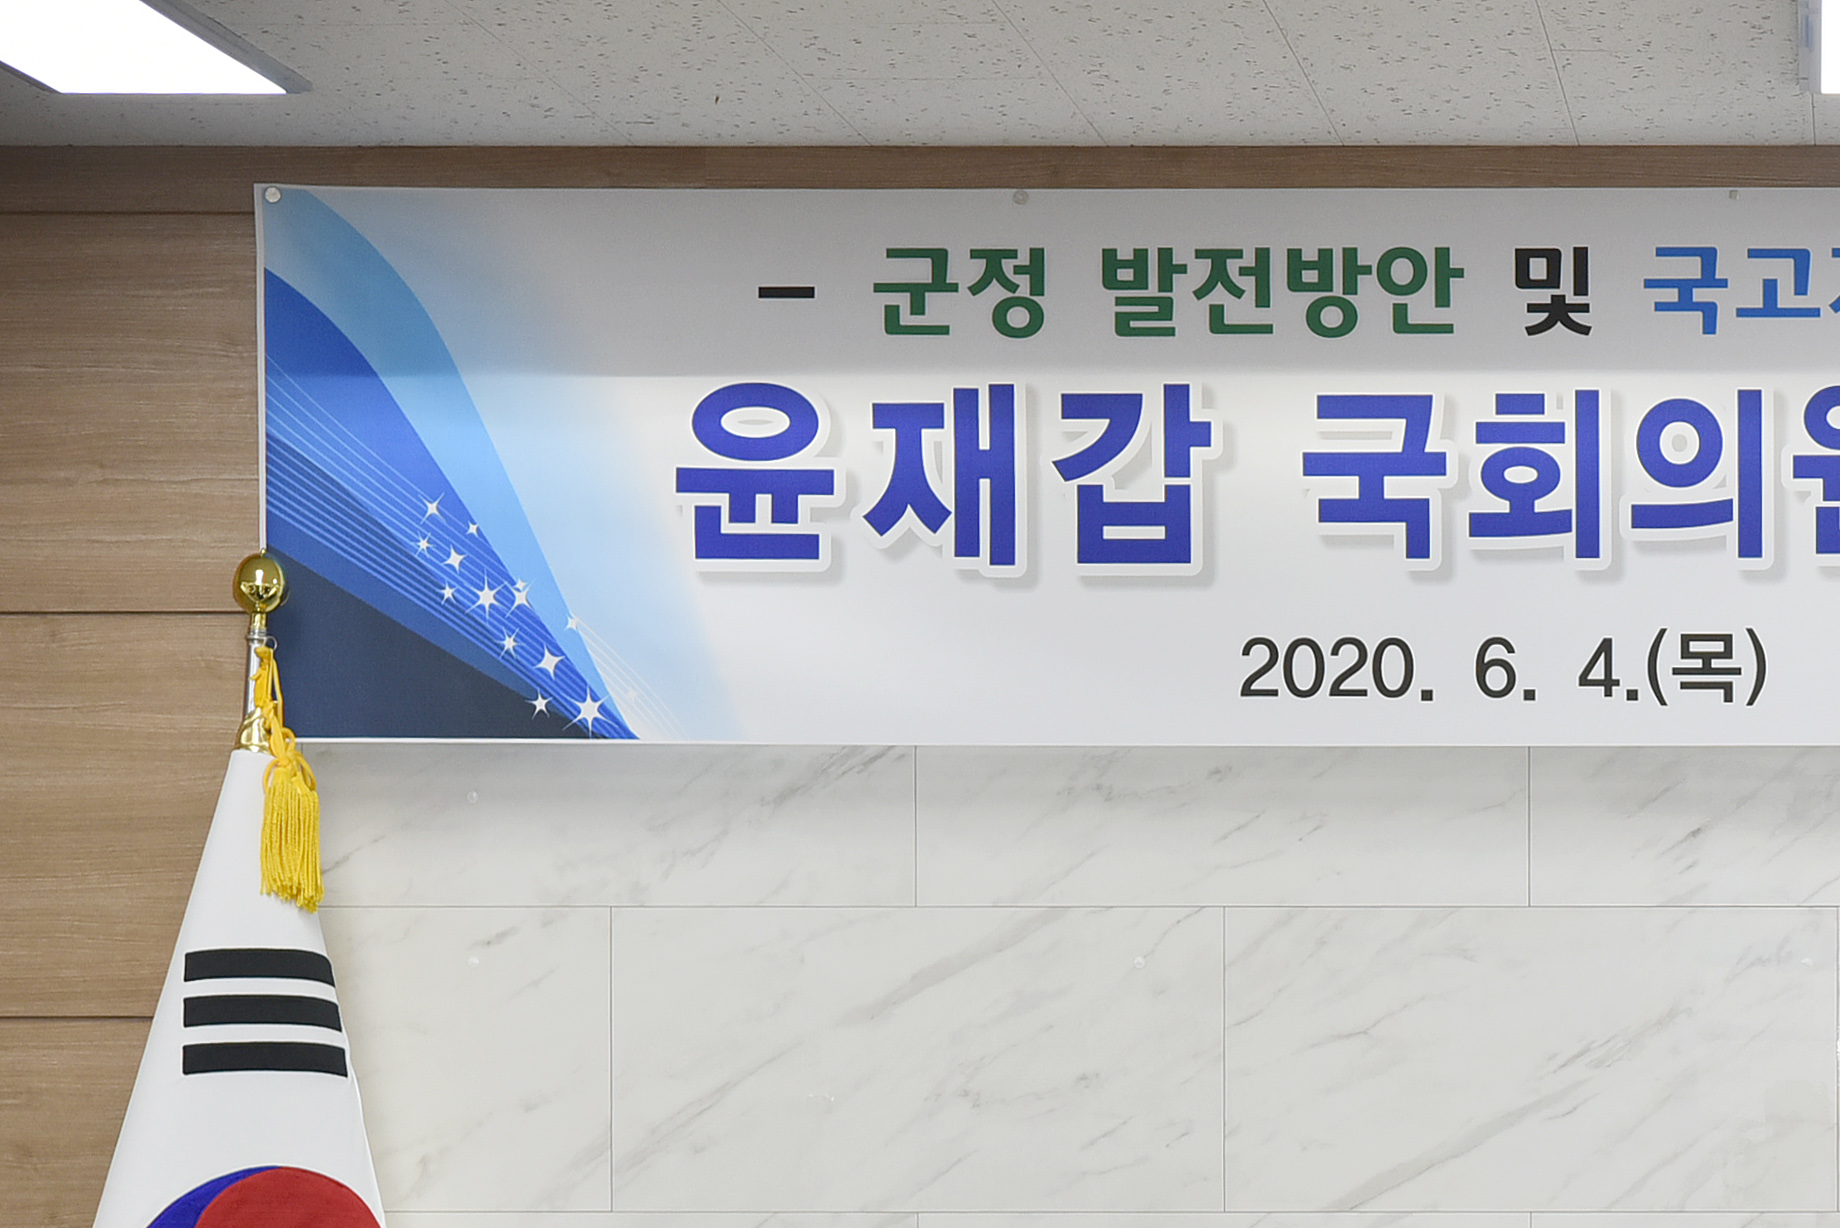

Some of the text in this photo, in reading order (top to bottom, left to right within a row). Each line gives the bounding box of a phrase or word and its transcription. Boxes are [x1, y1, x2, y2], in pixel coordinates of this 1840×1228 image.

[872, 245, 1048, 339] 군정
[1101, 245, 1465, 339] 발전방안
[1513, 245, 1593, 337] 및
[674, 381, 1214, 567] 윤재갑
[1240, 636, 1435, 702] 2020.
[1473, 636, 1538, 702] 6.
